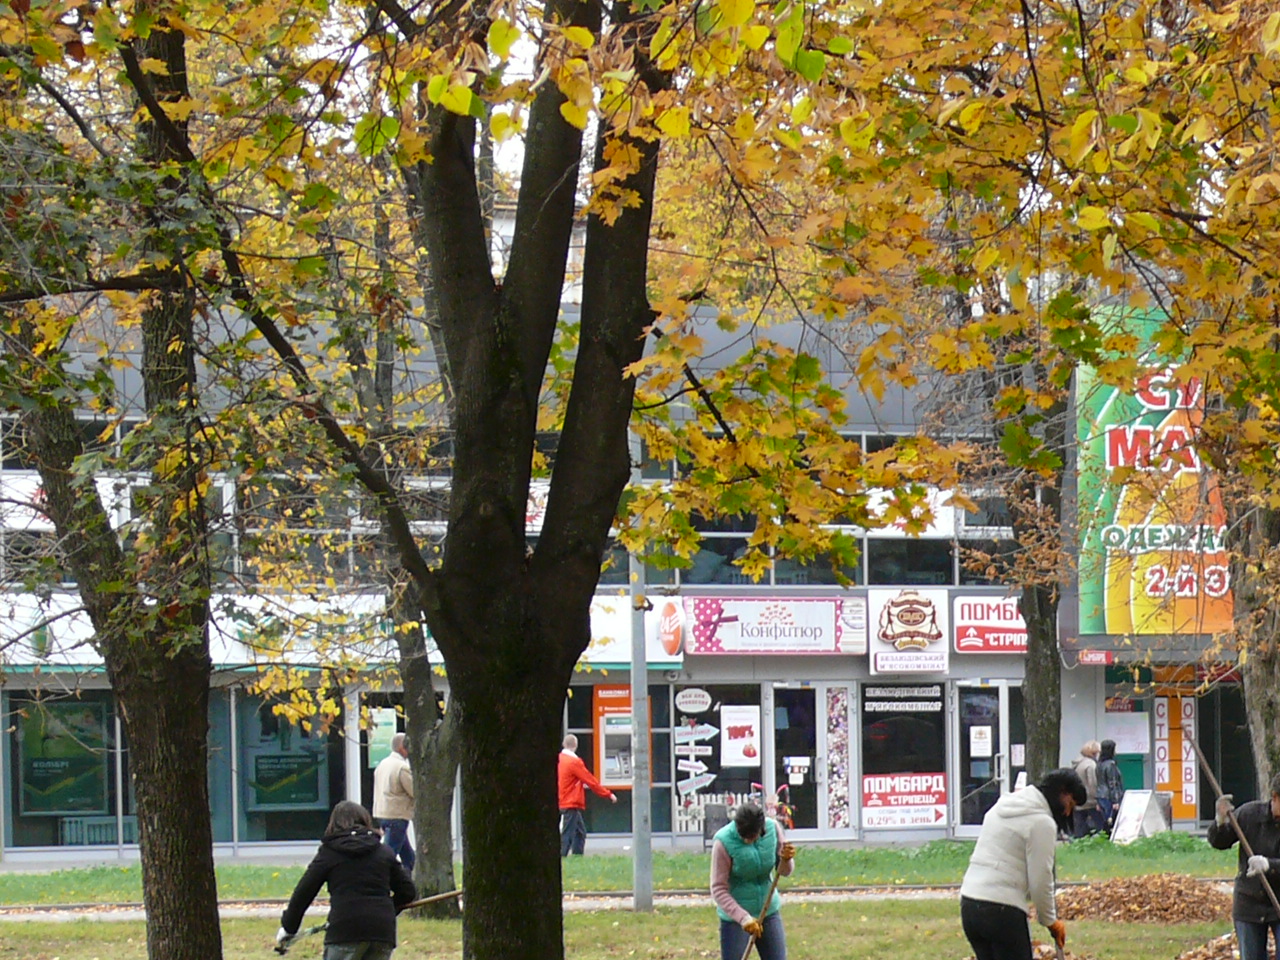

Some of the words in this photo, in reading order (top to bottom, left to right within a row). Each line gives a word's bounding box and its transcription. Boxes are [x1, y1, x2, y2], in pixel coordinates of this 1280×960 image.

[740, 621, 823, 641] Конфитюр
[1156, 703, 1167, 782] СТОК
[863, 775, 945, 794] ЛОМБАРД
